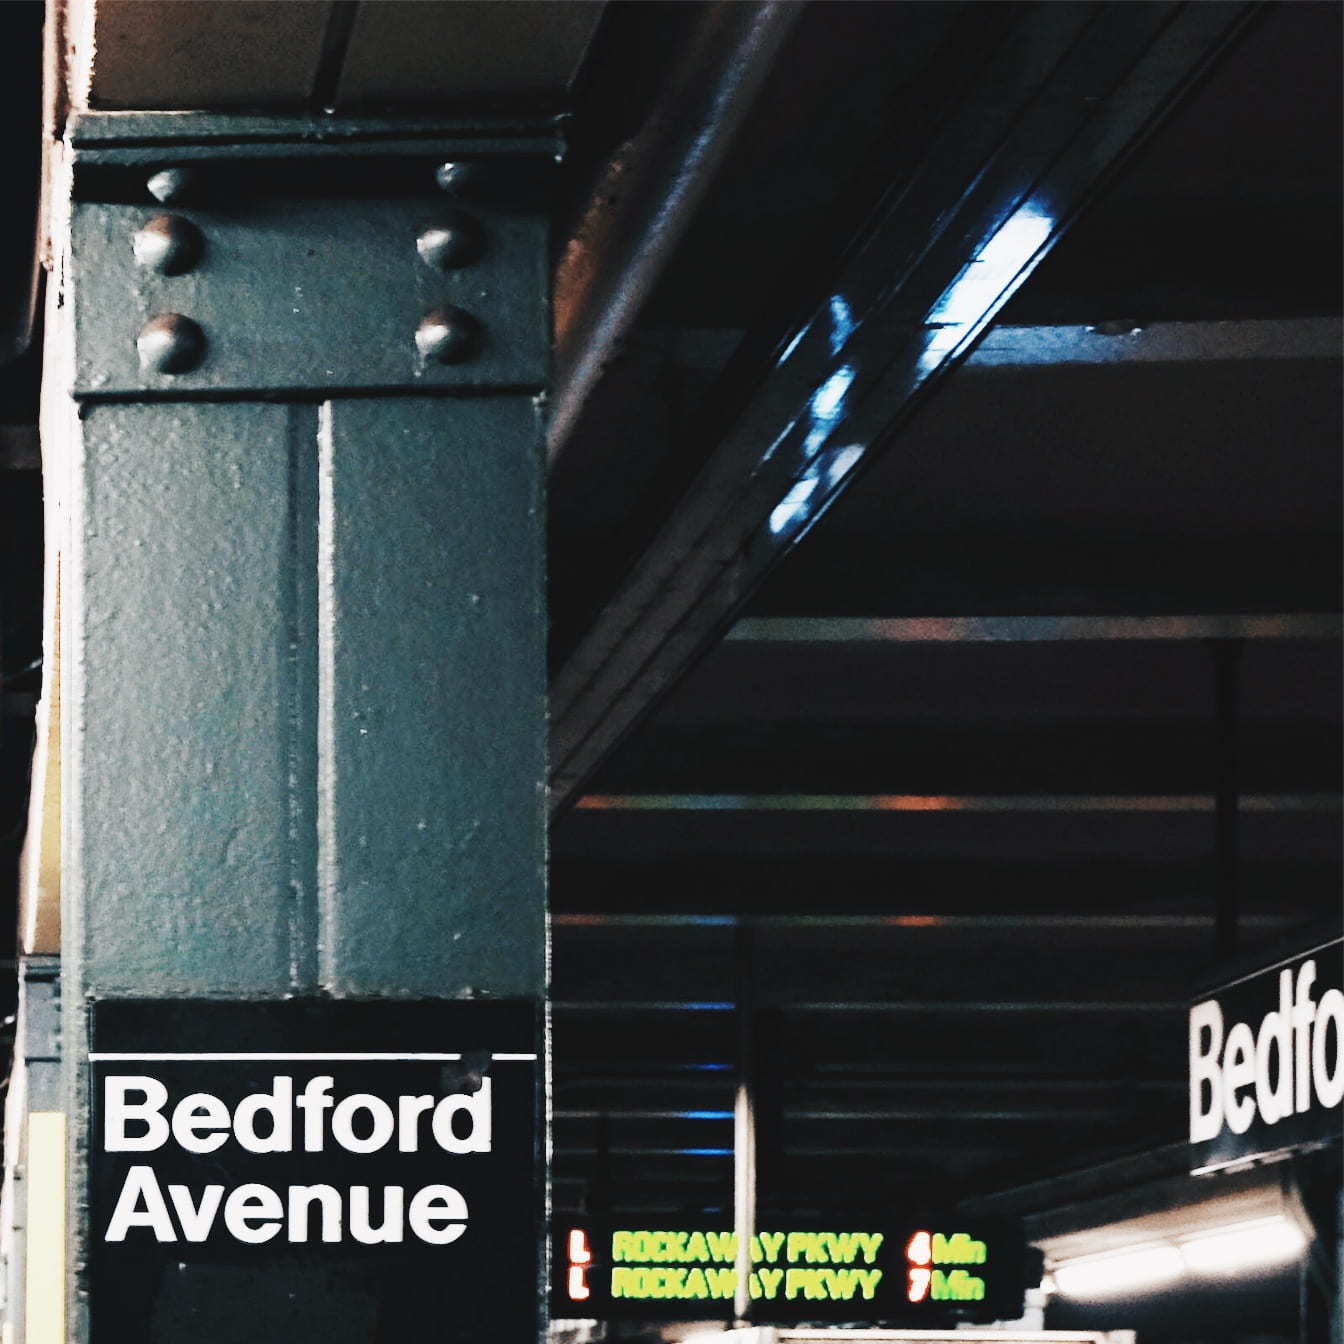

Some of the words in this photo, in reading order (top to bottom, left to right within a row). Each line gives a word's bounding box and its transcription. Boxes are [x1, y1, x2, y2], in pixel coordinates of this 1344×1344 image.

[1189, 960, 1344, 1143] Bedfo
[104, 1075, 492, 1154] Bedford
[104, 1165, 469, 1245] Avenue
[568, 1265, 590, 1300] L
[785, 1268, 883, 1300] PKWY
[569, 1229, 591, 1263] L
[787, 1232, 884, 1264] PKWY
